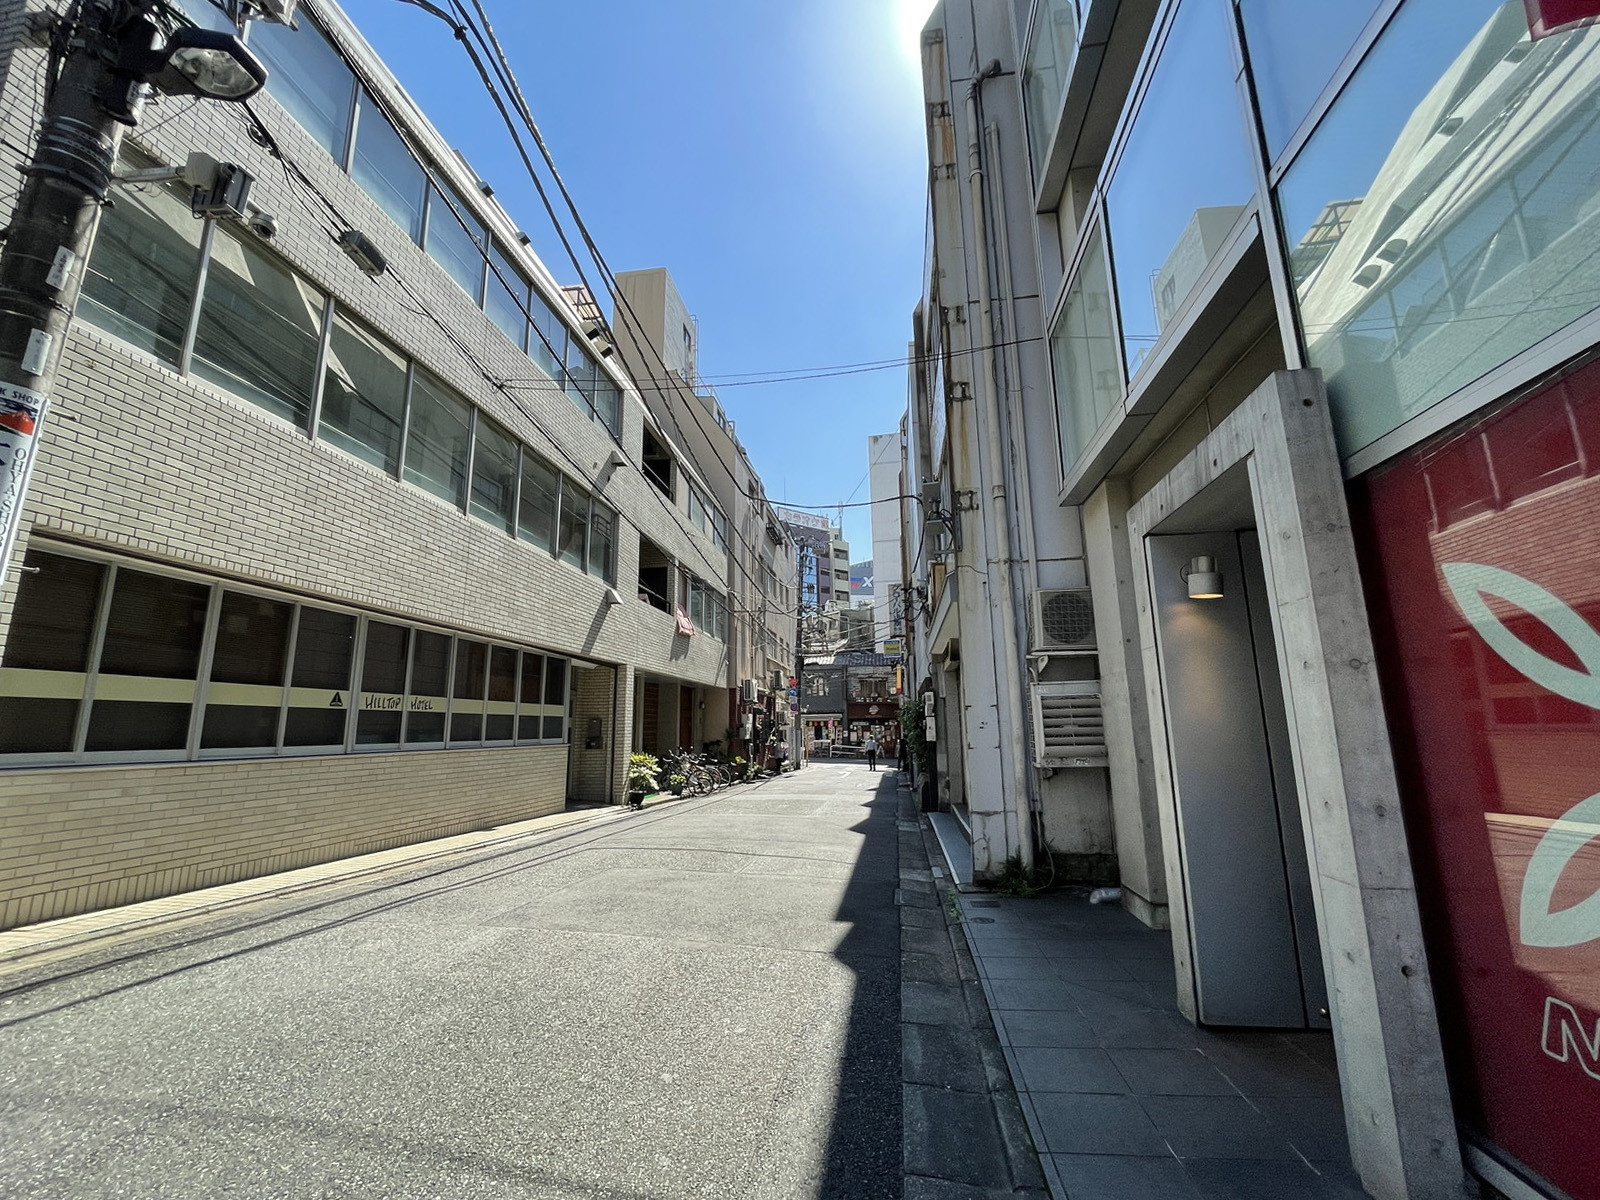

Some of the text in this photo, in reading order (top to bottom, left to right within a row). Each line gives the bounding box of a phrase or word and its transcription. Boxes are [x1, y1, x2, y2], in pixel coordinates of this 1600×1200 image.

[10, 390, 40, 406] SHOP
[365, 694, 433, 710] HILLTOP HOTEL
